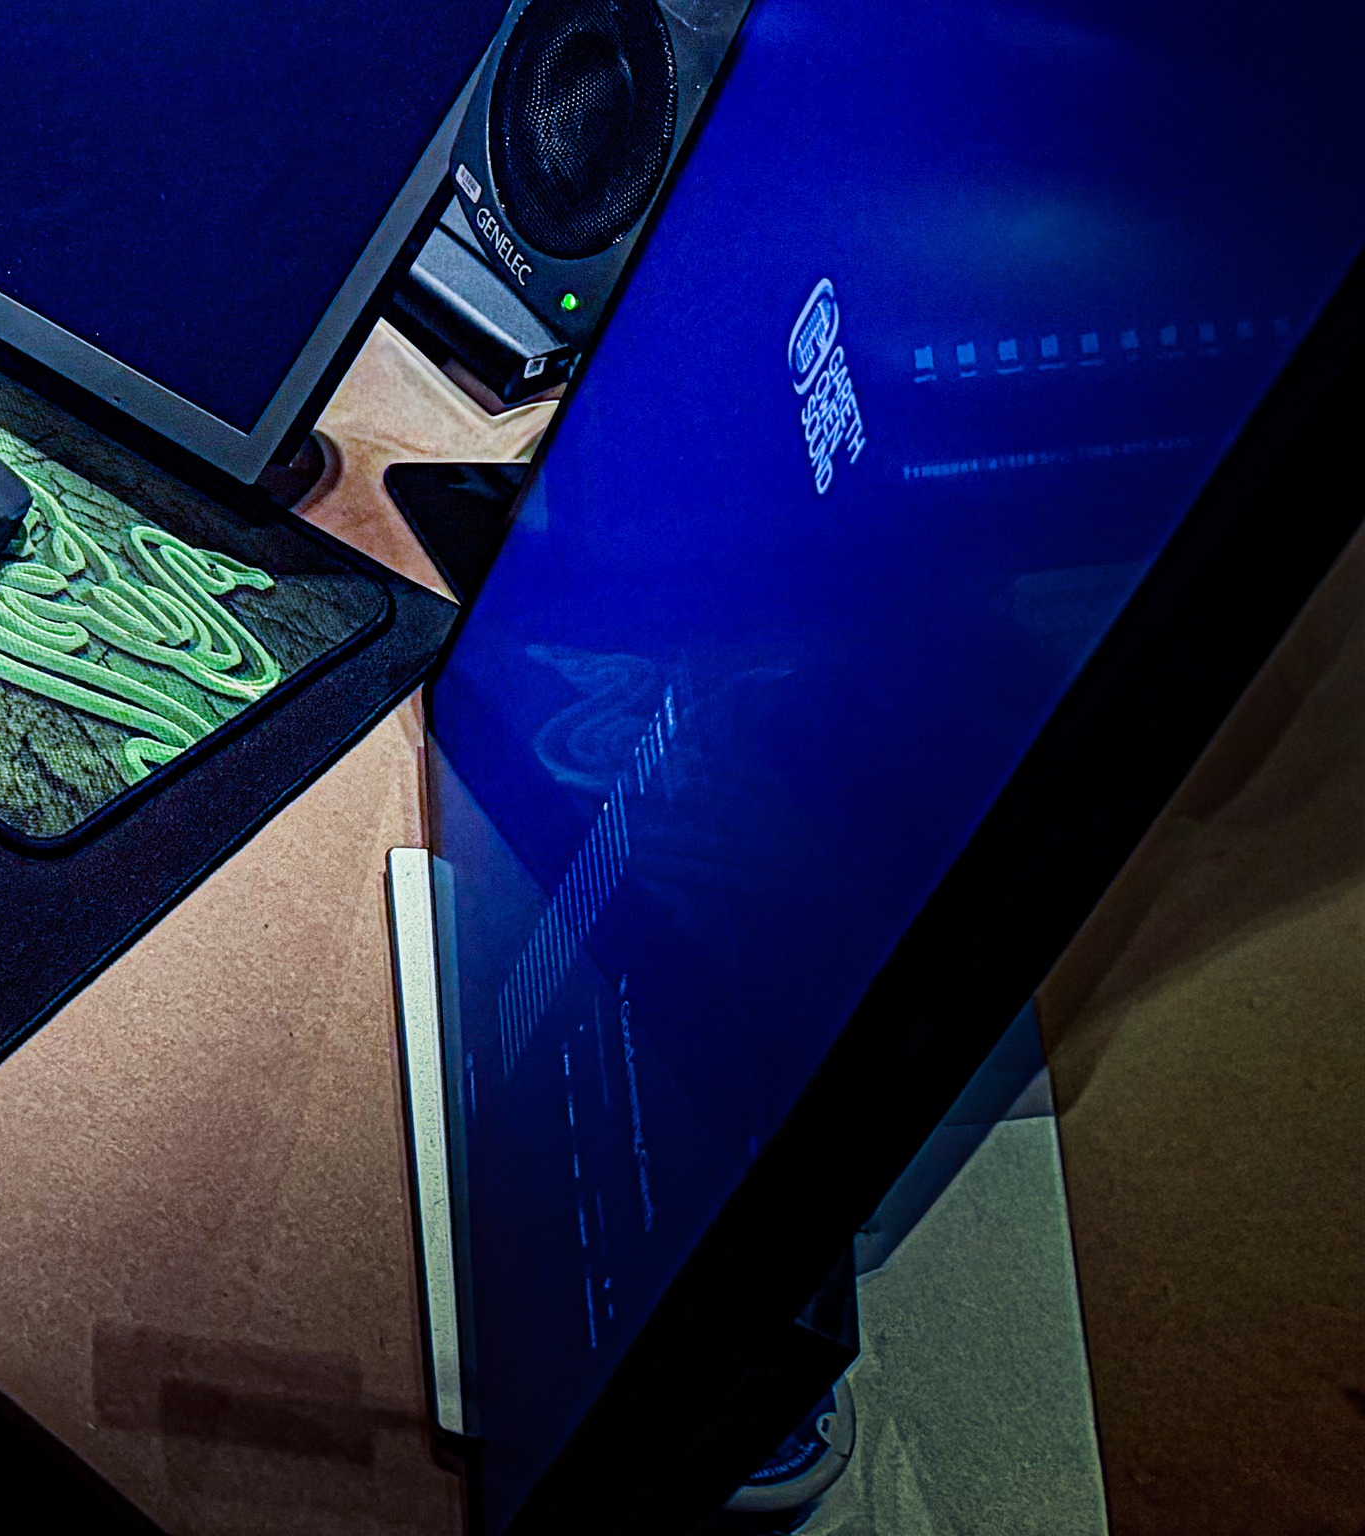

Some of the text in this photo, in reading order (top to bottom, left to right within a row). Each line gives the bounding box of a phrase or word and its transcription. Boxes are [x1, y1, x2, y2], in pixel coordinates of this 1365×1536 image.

[475, 207, 533, 286] GENELEC
[801, 394, 833, 495] SOUND
[815, 370, 843, 456] OWEN
[829, 345, 867, 464] GARETH
